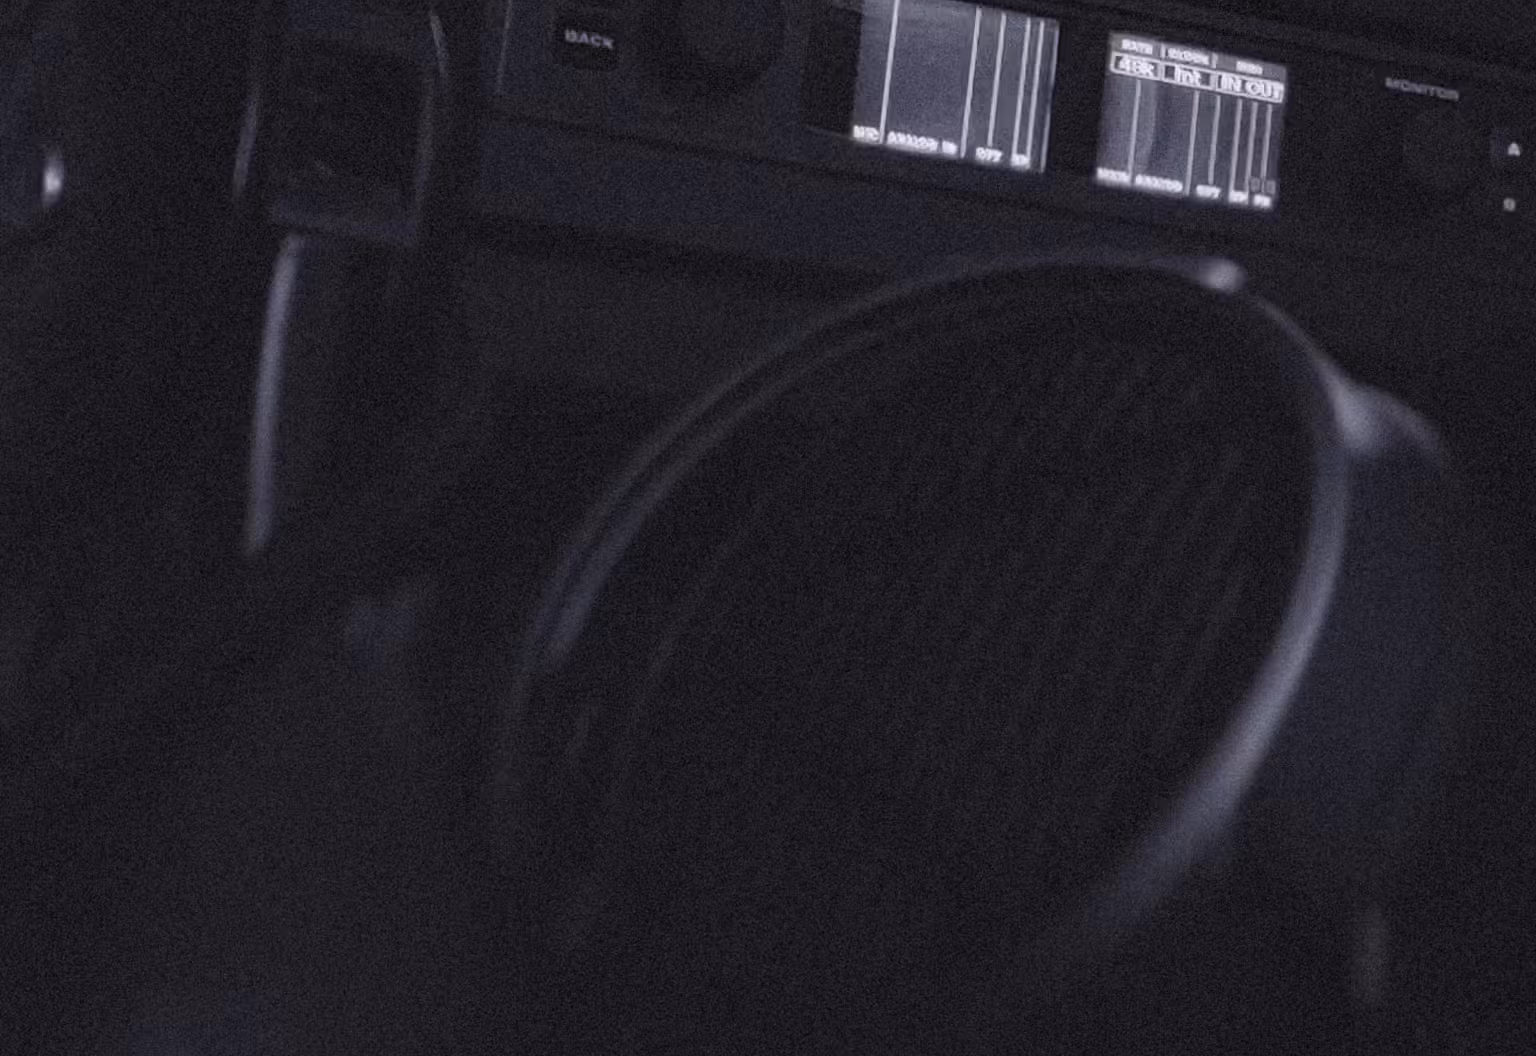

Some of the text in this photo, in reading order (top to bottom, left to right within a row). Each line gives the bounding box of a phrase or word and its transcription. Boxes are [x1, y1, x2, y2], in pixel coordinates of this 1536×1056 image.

[564, 28, 614, 51] BACK
[1221, 73, 1242, 92] IN
[1245, 79, 1285, 99] OUT
[1384, 76, 1460, 102] MONITOR
